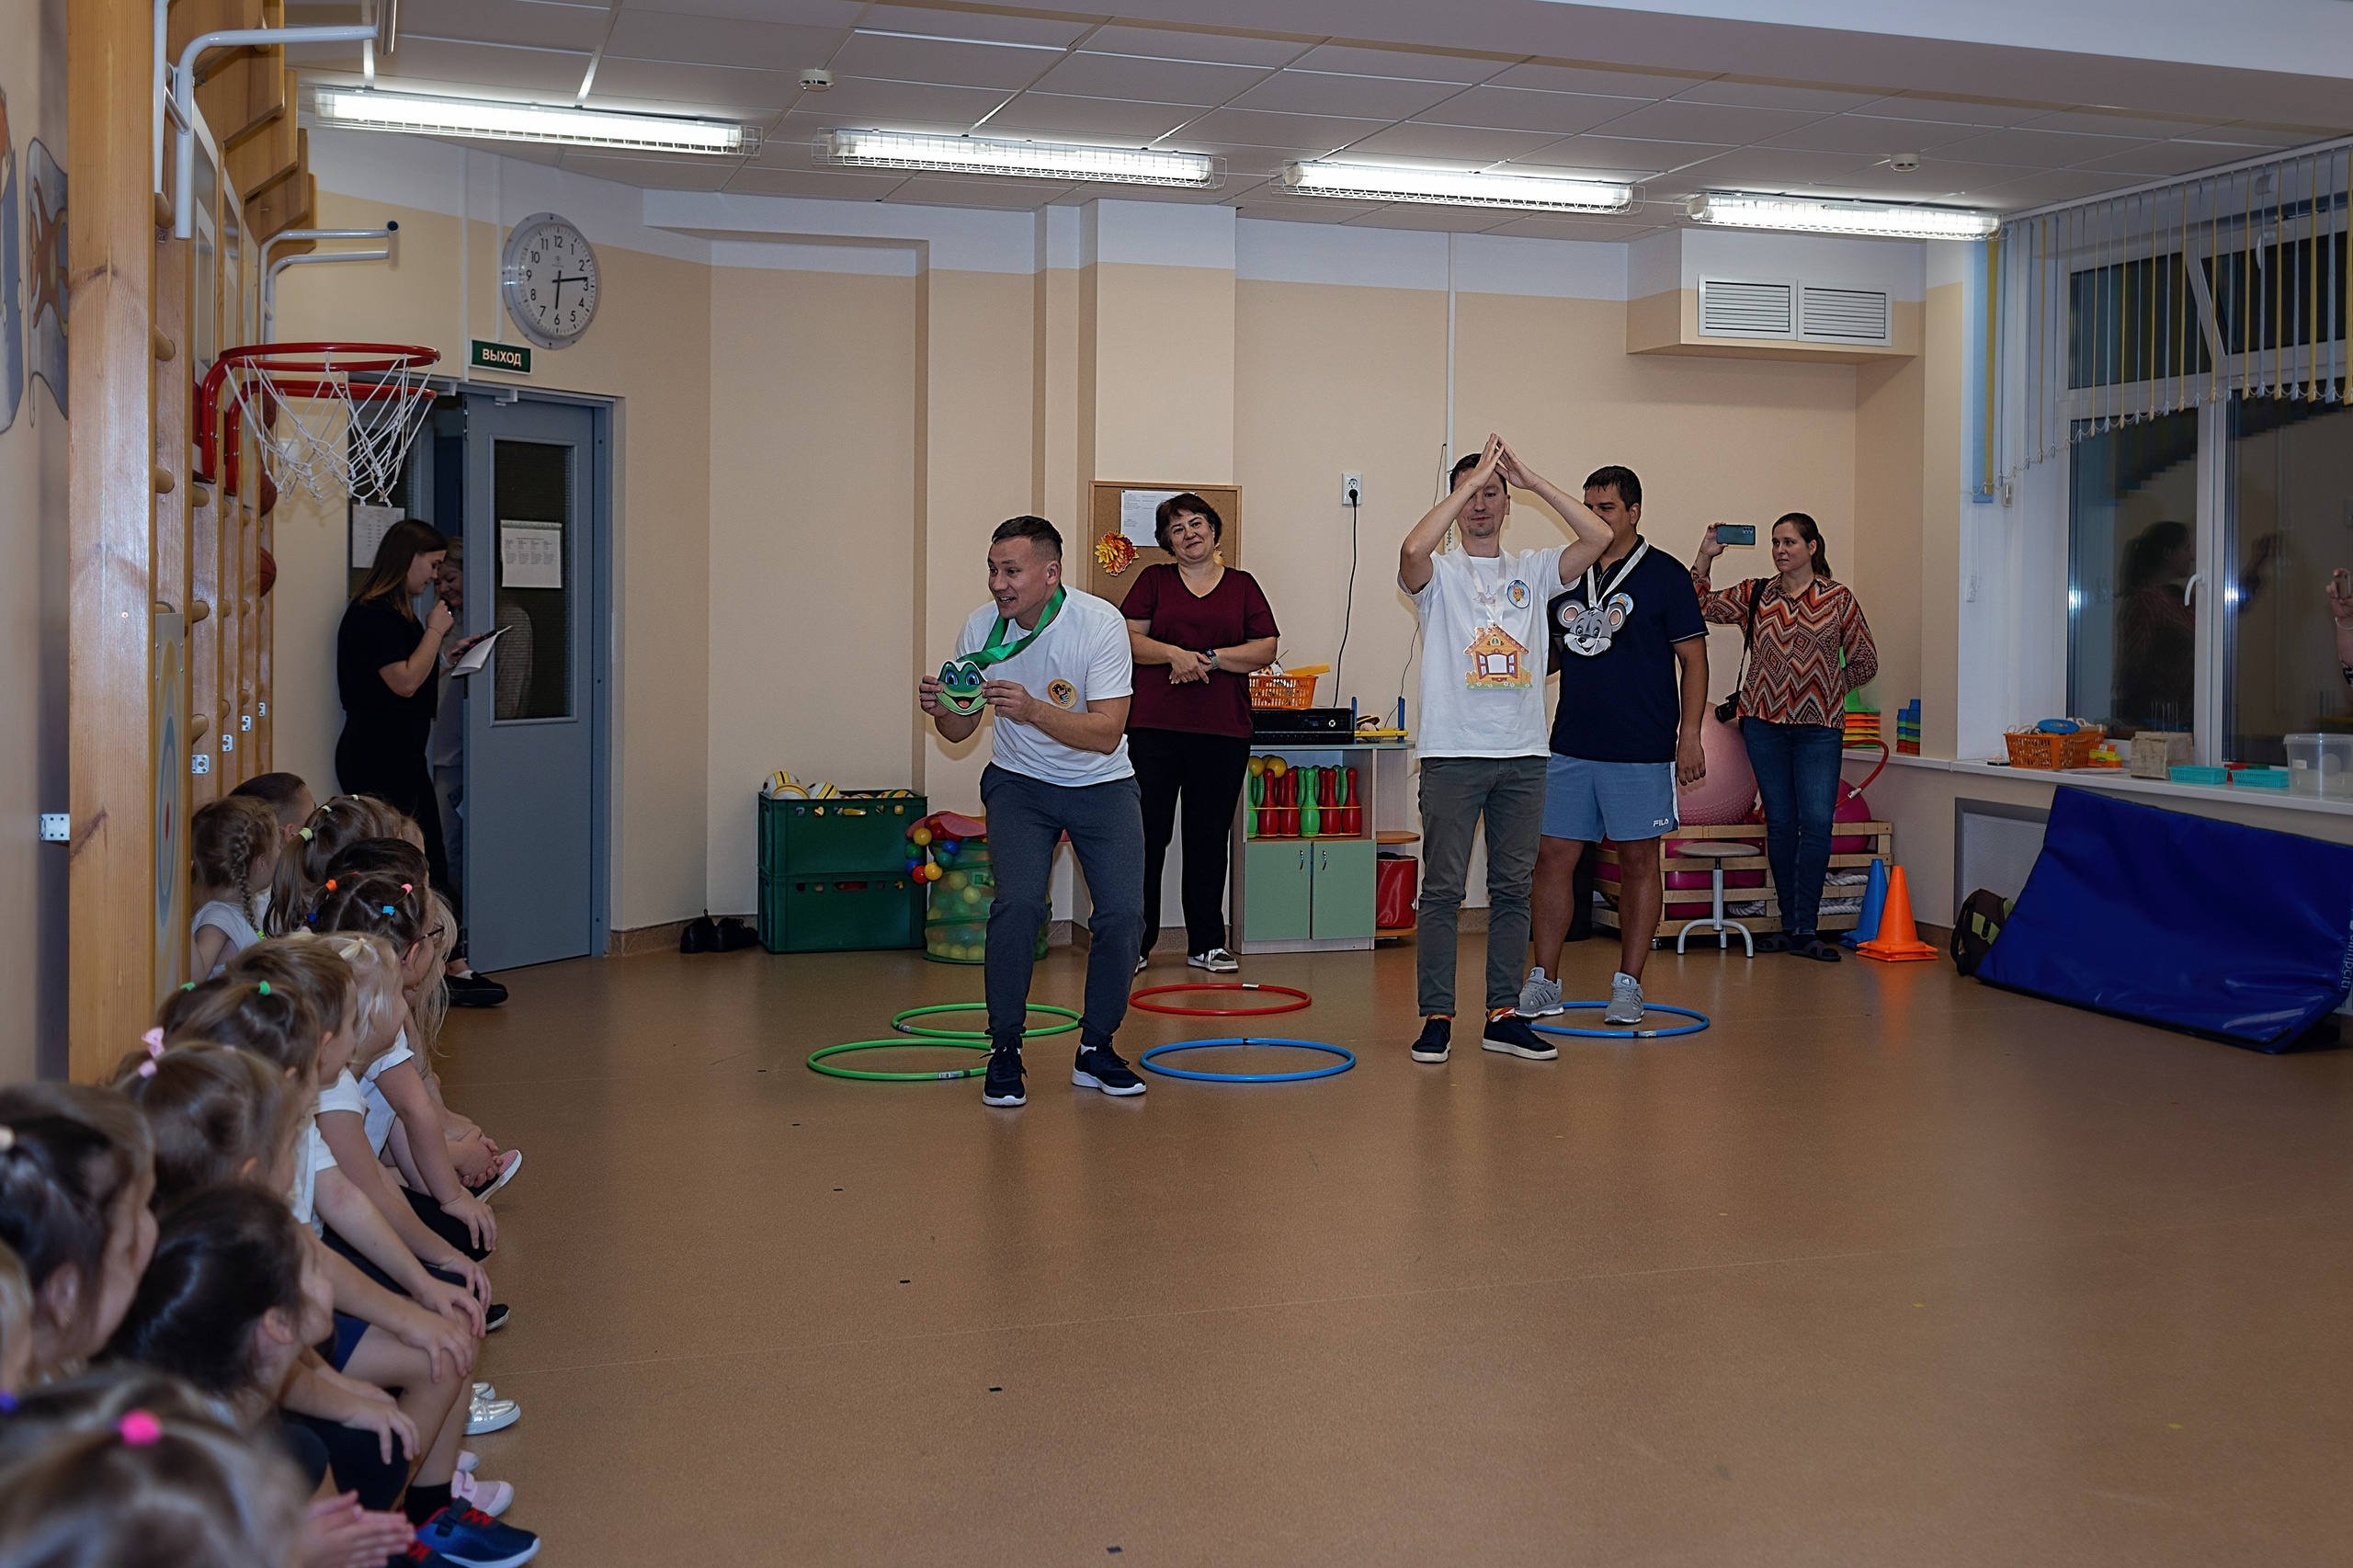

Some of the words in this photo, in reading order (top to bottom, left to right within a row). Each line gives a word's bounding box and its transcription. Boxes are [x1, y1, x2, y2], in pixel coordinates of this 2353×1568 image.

[540, 238, 549, 250] 11
[553, 235, 563, 248] 12
[571, 244, 574, 256] 1
[530, 251, 540, 264] 10
[579, 259, 585, 271] 2
[527, 269, 532, 281] 9
[583, 277, 589, 291] 3
[530, 289, 536, 301] 8
[578, 297, 585, 308] 4
[540, 305, 546, 317] 7
[570, 311, 575, 323] 5
[554, 313, 560, 325] 6
[483, 348, 521, 367] ВЫХОД
[1654, 818, 1668, 827] FILA
